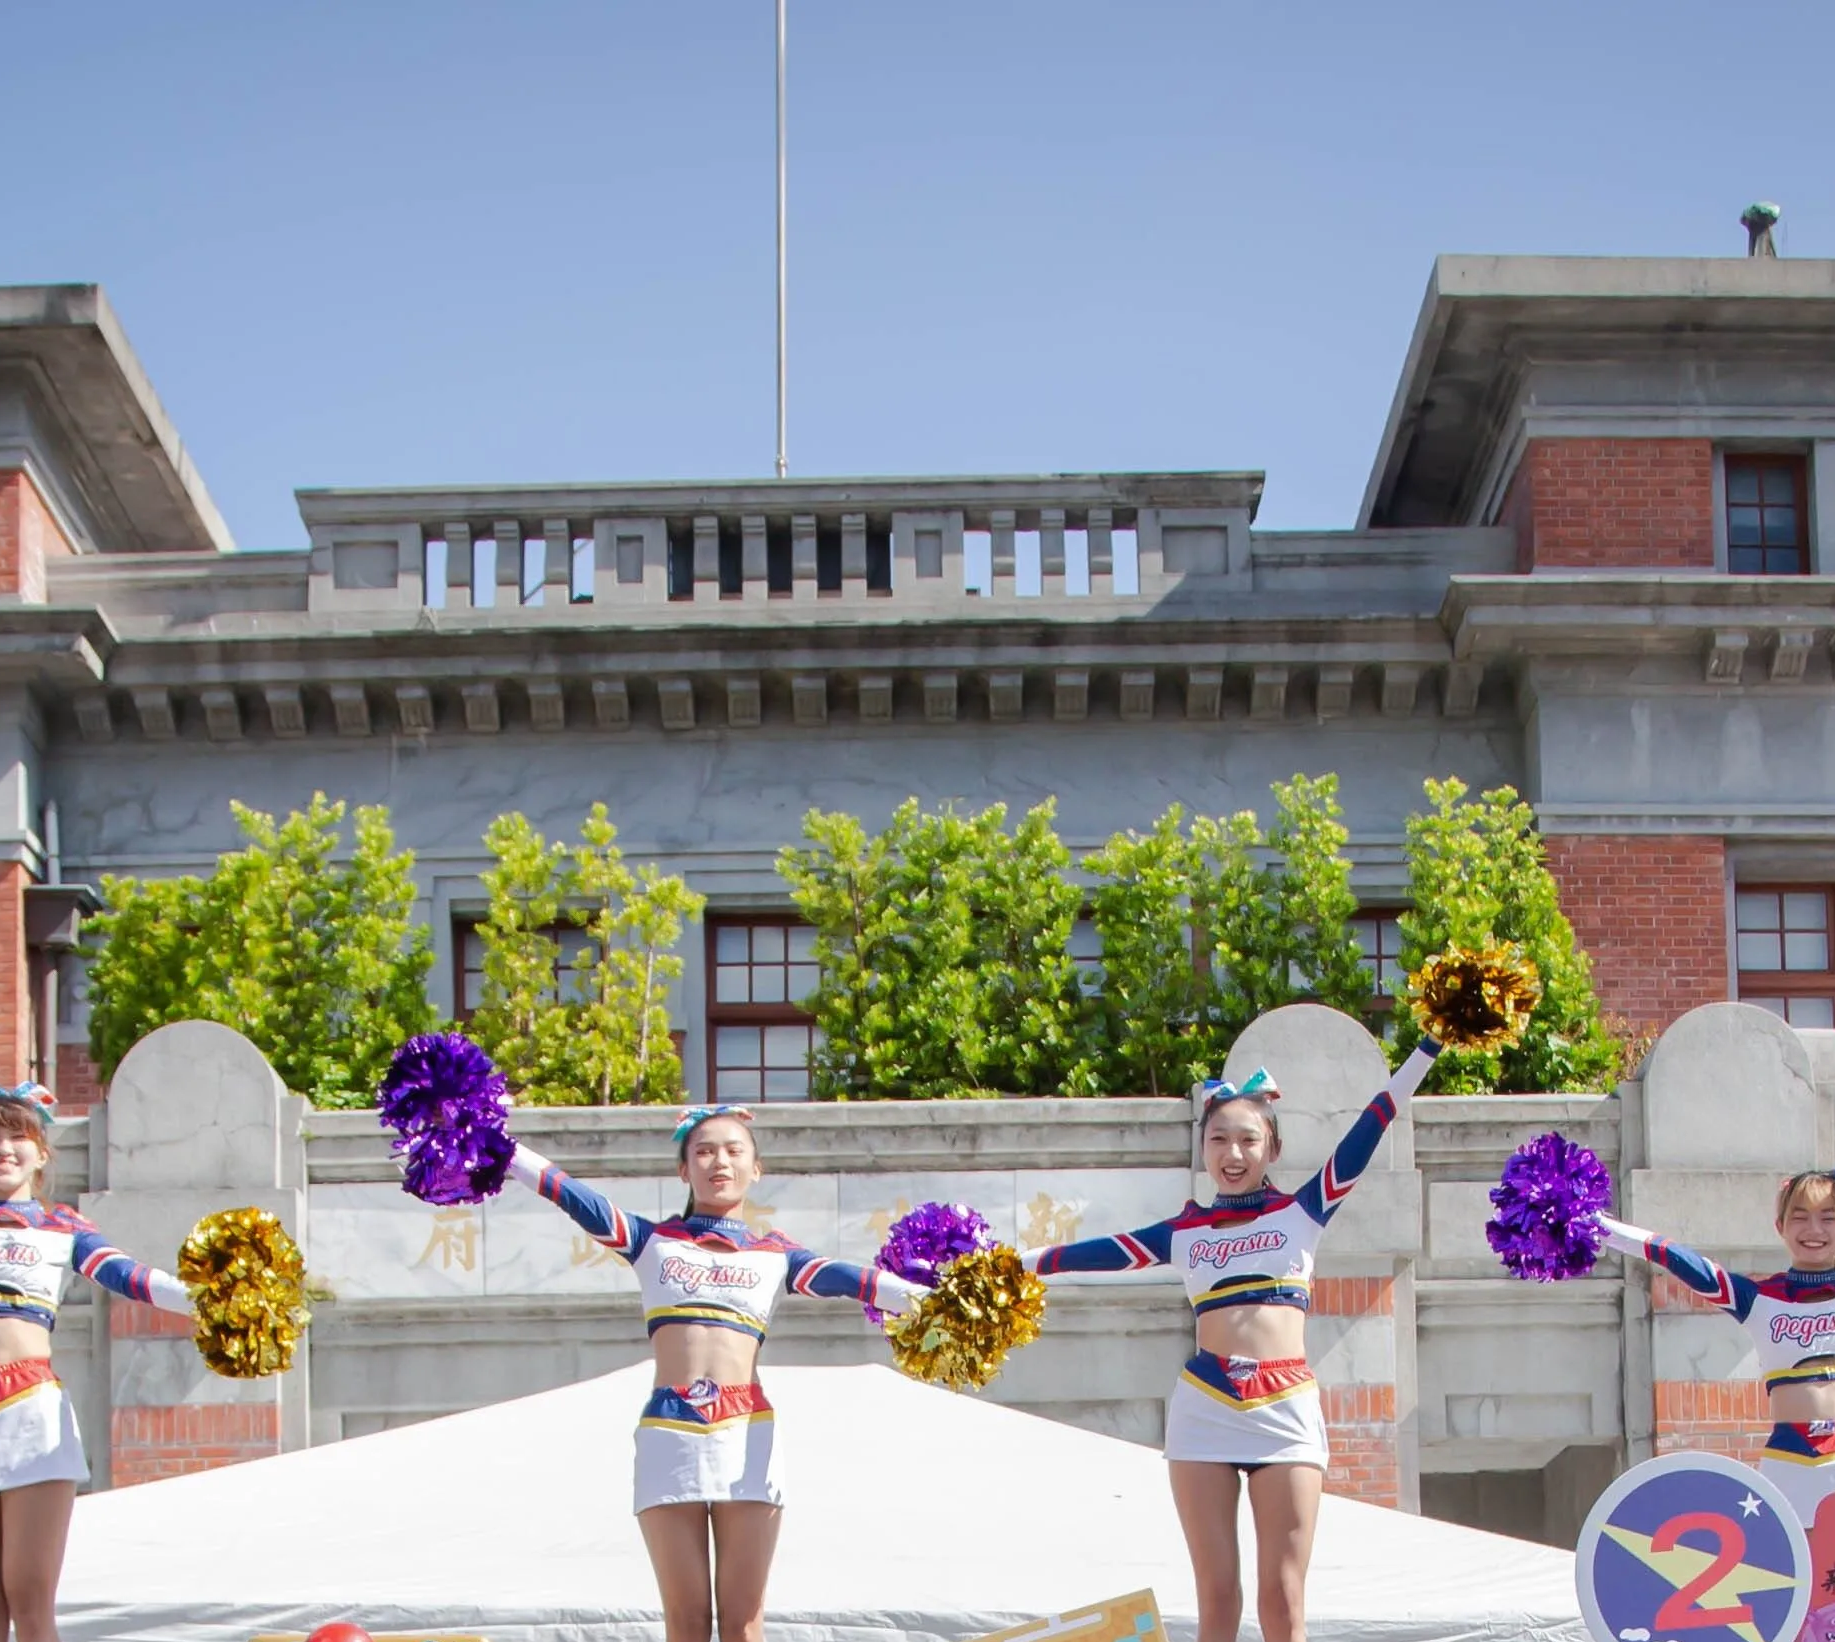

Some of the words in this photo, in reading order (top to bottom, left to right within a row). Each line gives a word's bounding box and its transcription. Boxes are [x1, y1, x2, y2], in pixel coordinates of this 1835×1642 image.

[1190, 1230, 1287, 1268] Pegasus
[660, 1256, 760, 1293] Pegasus
[1651, 1512, 1753, 1630] 2
